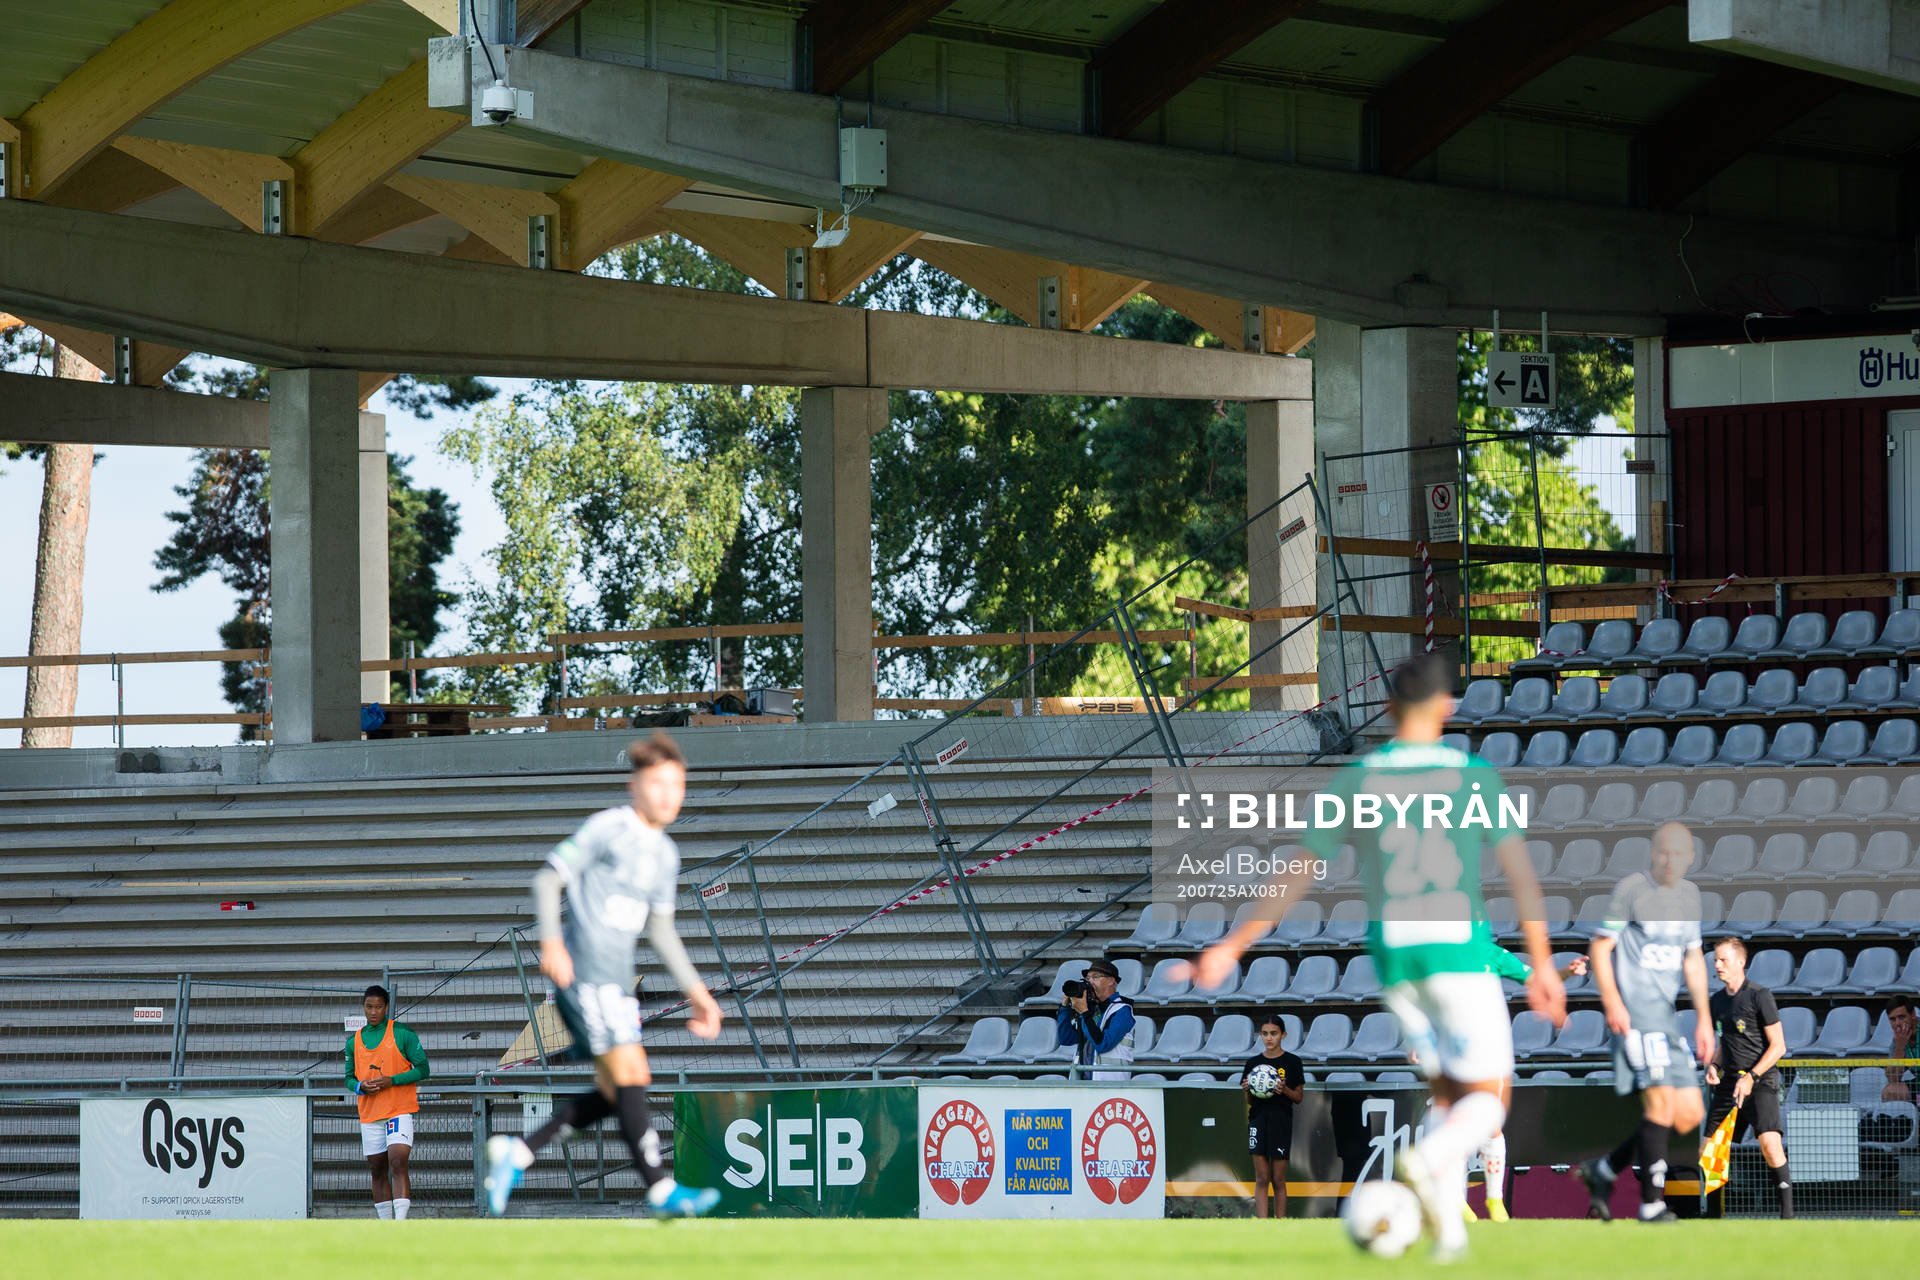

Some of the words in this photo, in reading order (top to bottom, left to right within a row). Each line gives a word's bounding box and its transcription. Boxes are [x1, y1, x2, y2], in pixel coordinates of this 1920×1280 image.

[1520, 355, 1550, 364] SEKTION
[1524, 369, 1546, 400] A
[927, 1103, 993, 1158] VAGGERYDS
[1011, 1113, 1033, 1130] NÄR
[1035, 1116, 1064, 1130] SMAK
[1084, 1102, 1154, 1157] VAGGERYDS
[142, 1098, 245, 1188] Qsys
[1027, 1136, 1049, 1150] OCH
[722, 1117, 867, 1189] SEB
[928, 1161, 990, 1179] CHARK
[1015, 1157, 1061, 1171] KVALITET
[1085, 1159, 1151, 1178] CHARK
[1007, 1174, 1027, 1191] FÅR
[1028, 1174, 1070, 1191] AVGÖRA
[151, 1196, 179, 1205] SUPPORT
[201, 1196, 244, 1205] LAGERSYSTEM
